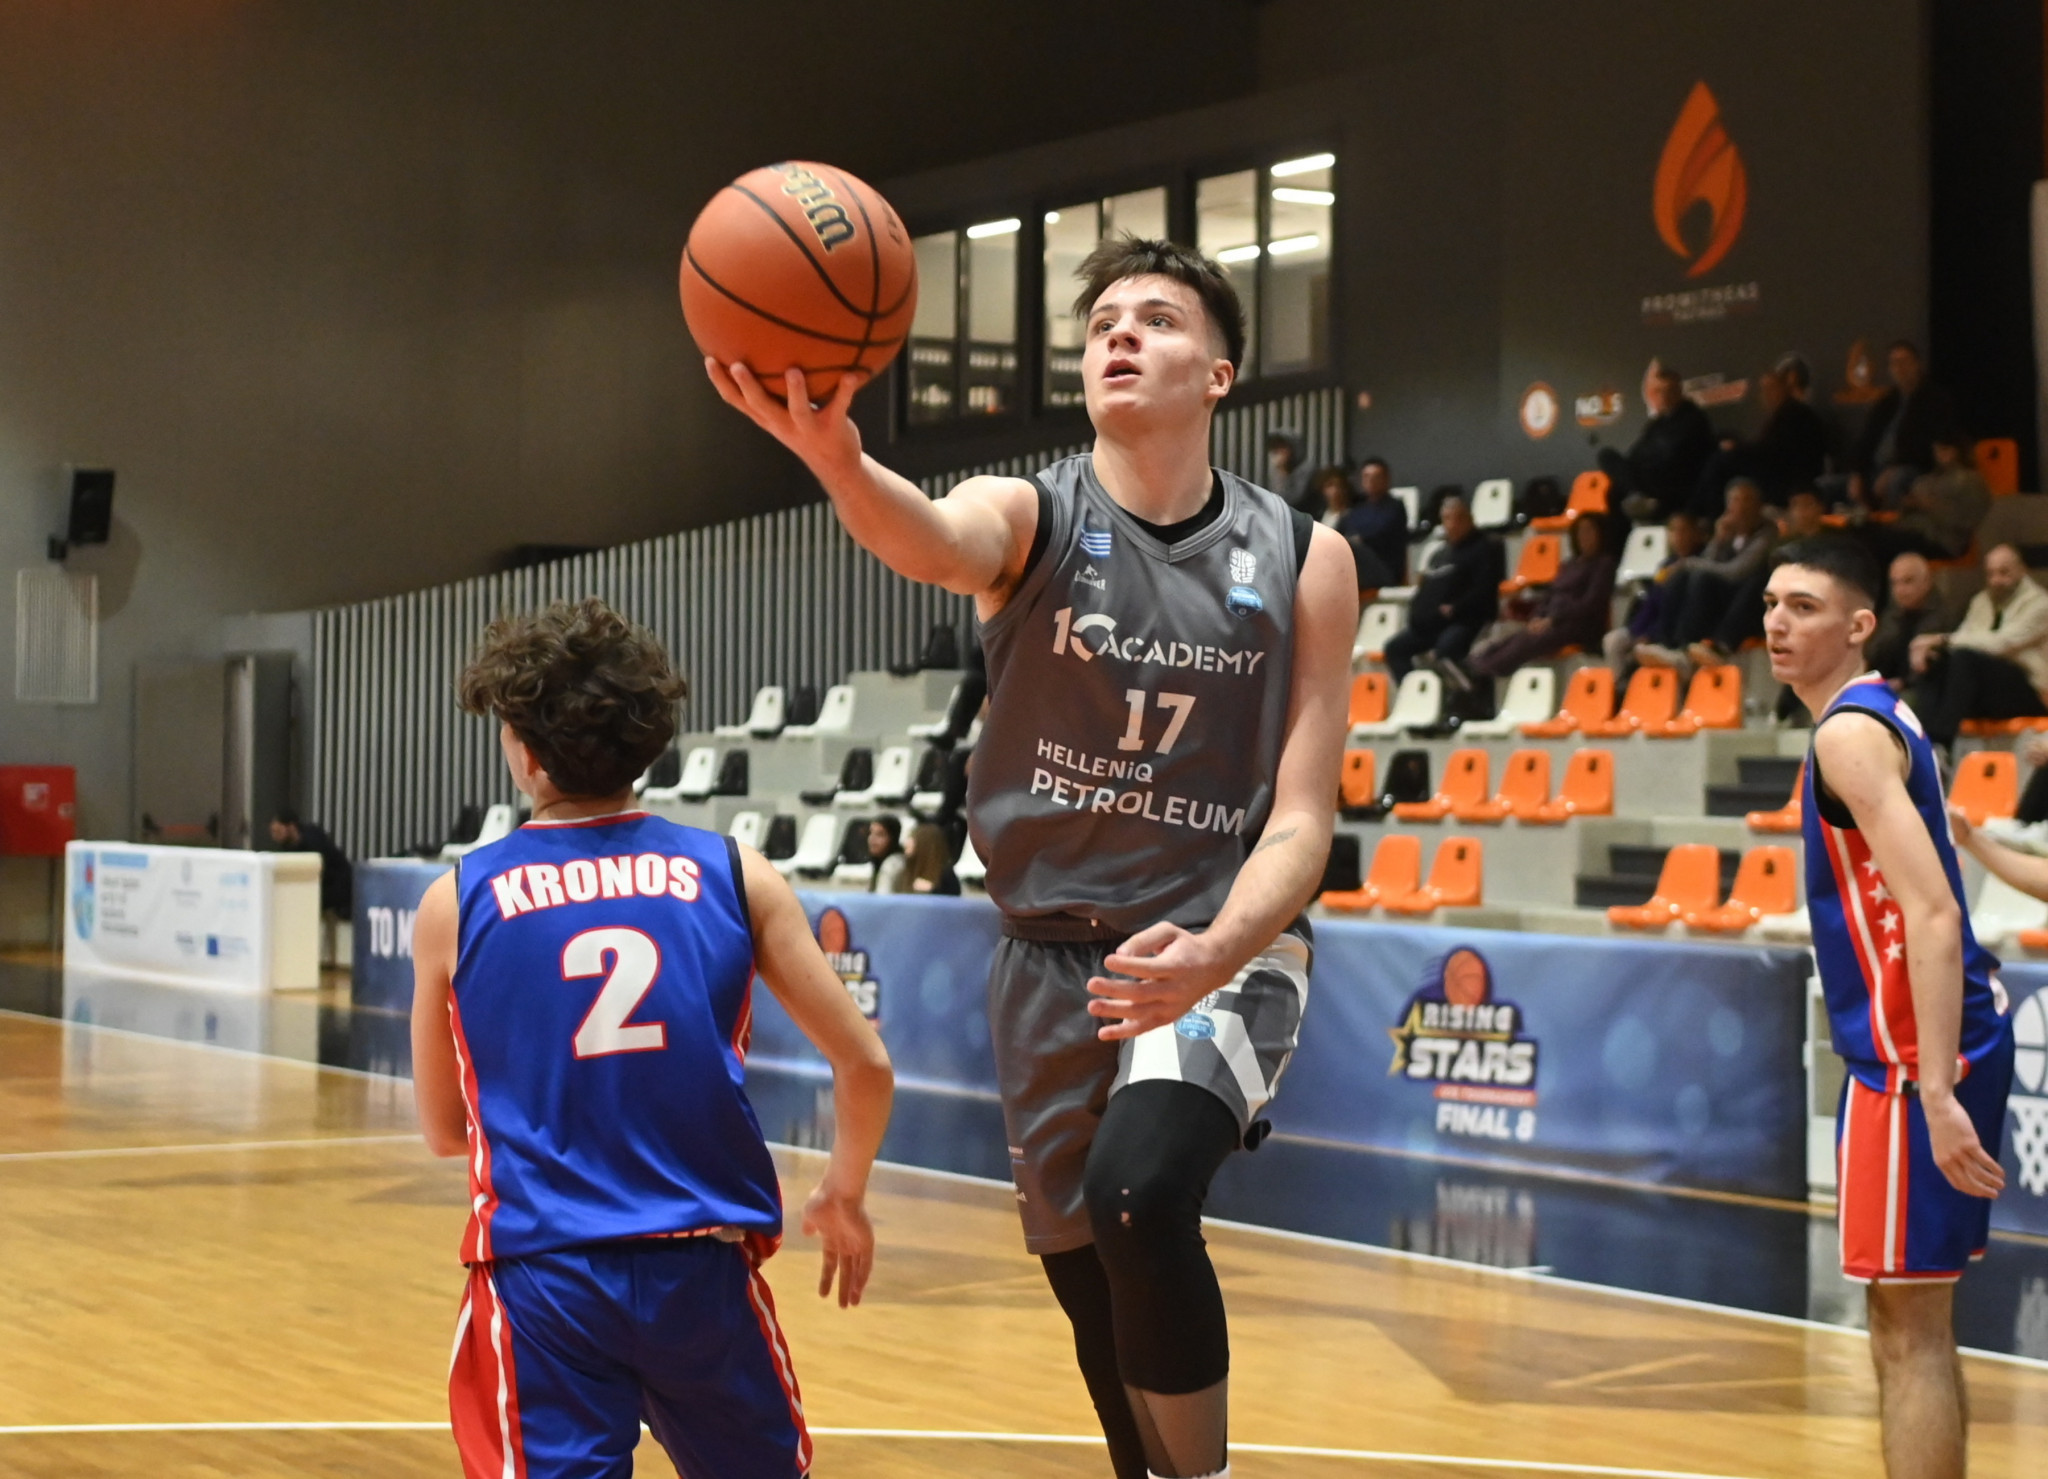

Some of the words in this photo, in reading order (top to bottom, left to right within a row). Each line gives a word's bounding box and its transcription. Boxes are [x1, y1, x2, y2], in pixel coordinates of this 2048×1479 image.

[1117, 688, 1196, 755] 17
[1030, 767, 1247, 836] PETROLEUM
[490, 851, 701, 921] KRONOS
[367, 906, 394, 959] TO
[559, 925, 668, 1060] 2
[1423, 1002, 1514, 1032] RISING
[1406, 1037, 1535, 1085] STARS
[1436, 1102, 1511, 1139] FINAL
[1515, 1109, 1536, 1141] 8
